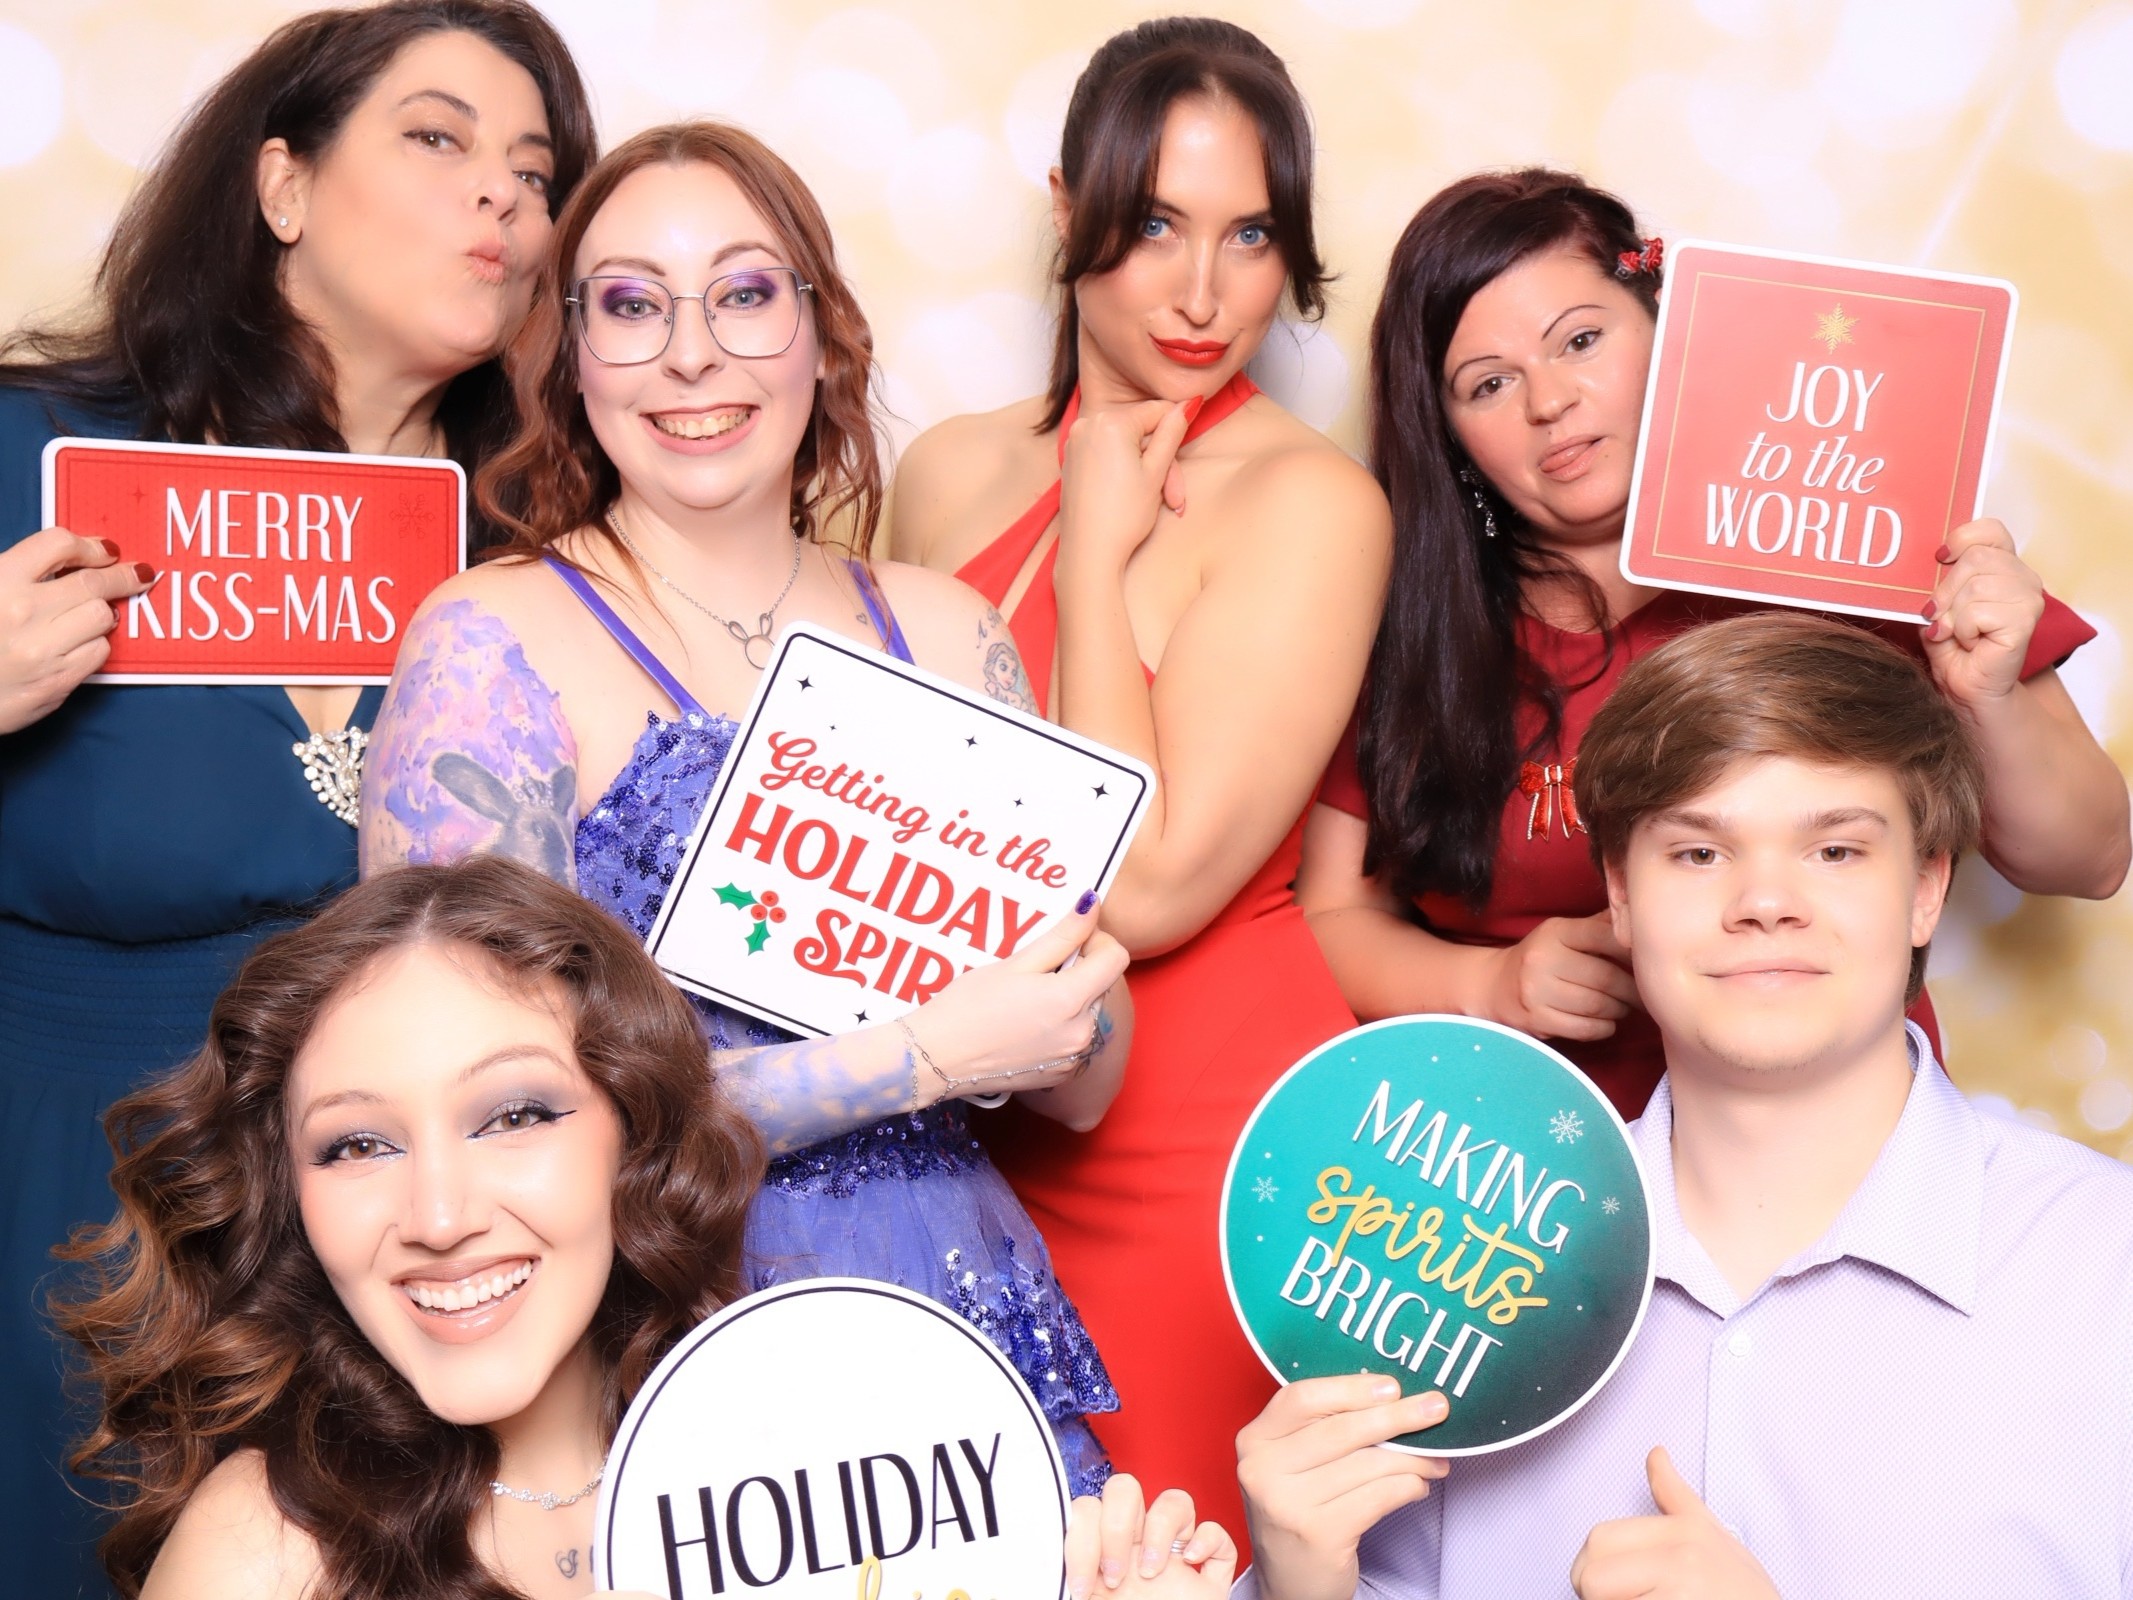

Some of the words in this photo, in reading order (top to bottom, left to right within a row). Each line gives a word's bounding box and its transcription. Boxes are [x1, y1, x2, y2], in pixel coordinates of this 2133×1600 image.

[1766, 361, 1885, 432] JOY
[166, 486, 363, 563] MERRY
[1705, 483, 1903, 569] WORLD
[1739, 432, 1793, 482] to
[1802, 435, 1886, 495] the
[128, 569, 397, 644] KISS-MAS
[759, 731, 932, 845] Getting
[940, 809, 990, 858] in
[996, 834, 1068, 889] the
[724, 792, 1048, 960] HOLIDAY
[793, 909, 976, 1006] SPIR
[1352, 1079, 1586, 1254] MAKING
[1306, 1166, 1549, 1325] spirits
[1280, 1236, 1503, 1398] BRIGHT
[657, 1432, 1001, 1600] HOLIDAY
